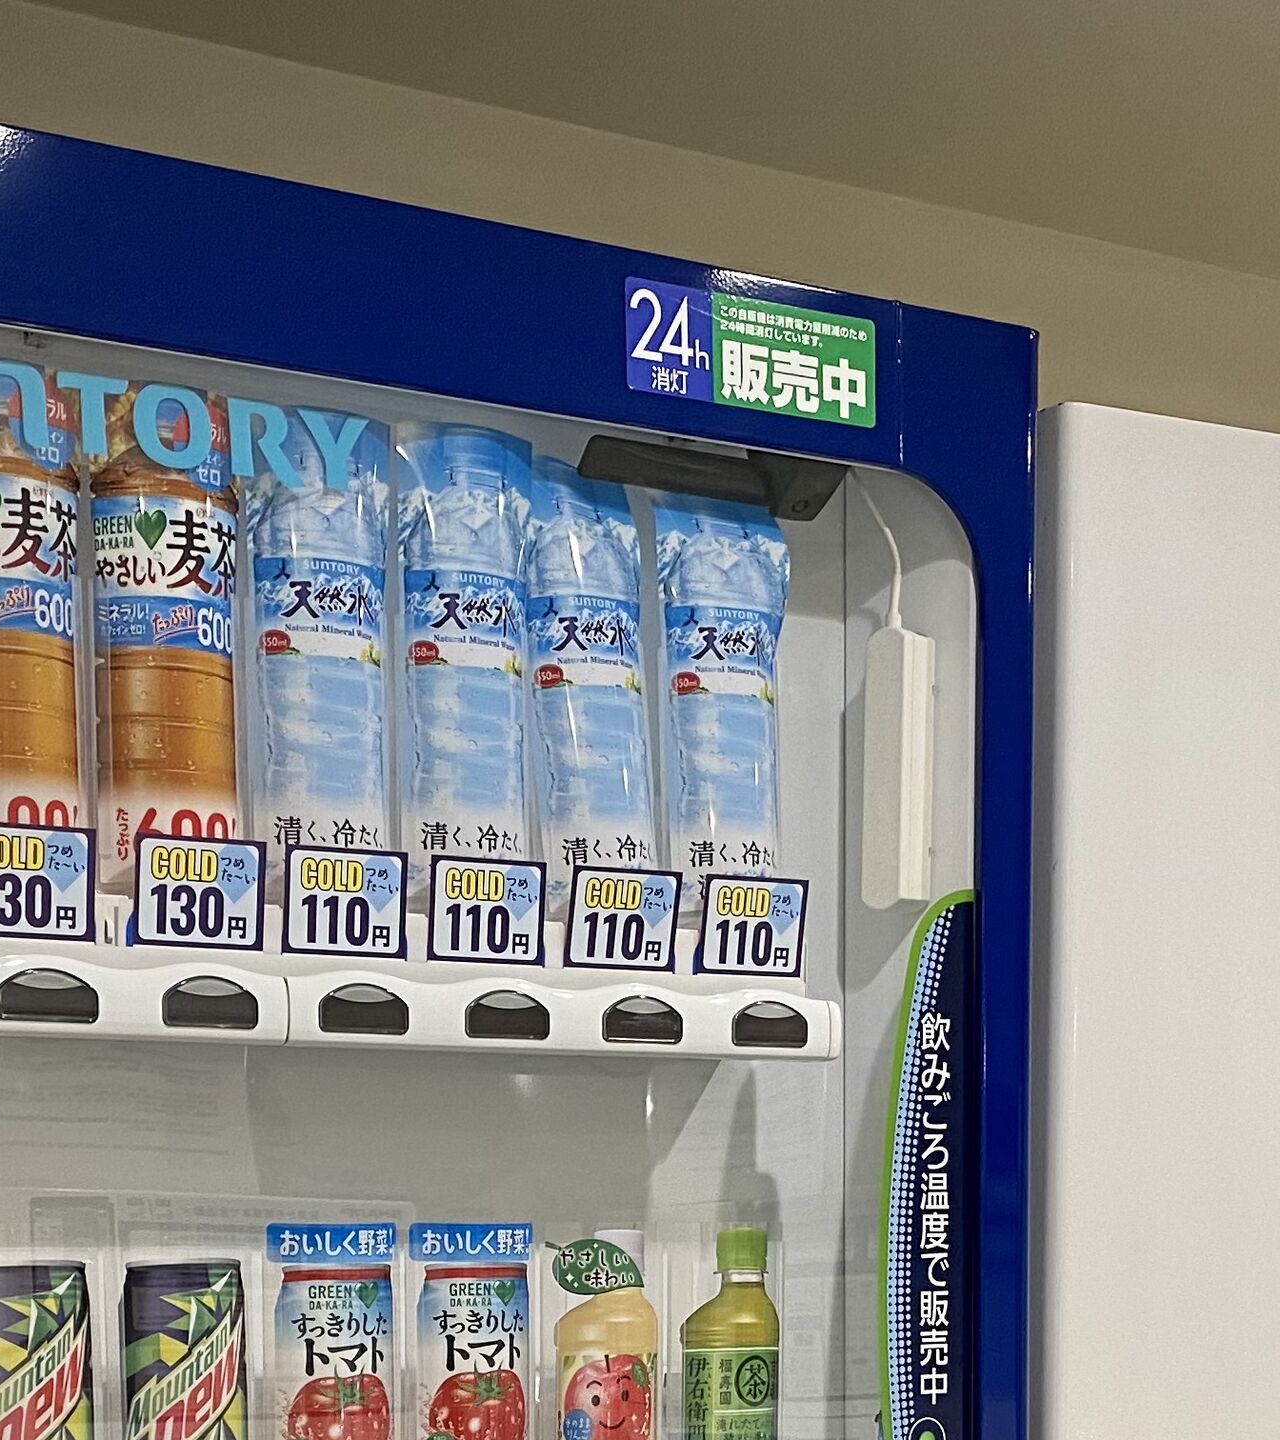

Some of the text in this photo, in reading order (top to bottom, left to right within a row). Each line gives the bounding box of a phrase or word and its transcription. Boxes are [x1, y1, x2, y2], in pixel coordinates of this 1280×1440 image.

[630, 288, 710, 370] 24h
[652, 366, 688, 394] 消灯
[721, 340, 866, 419] 販売中
[93, 516, 133, 539] GREEN
[304, 559, 360, 574] SUNTORY
[280, 580, 374, 626] 天然水
[551, 614, 635, 654] 天然水
[300, 856, 364, 893] COLD
[717, 885, 770, 918] COLD
[919, 1011, 950, 1404] 飲みごろ温度で販売中
[558, 1247, 629, 1267] やさしい
[583, 1269, 635, 1287] 味わい
[291, 1311, 388, 1339] すっきりした
[304, 1337, 386, 1376] トマト
